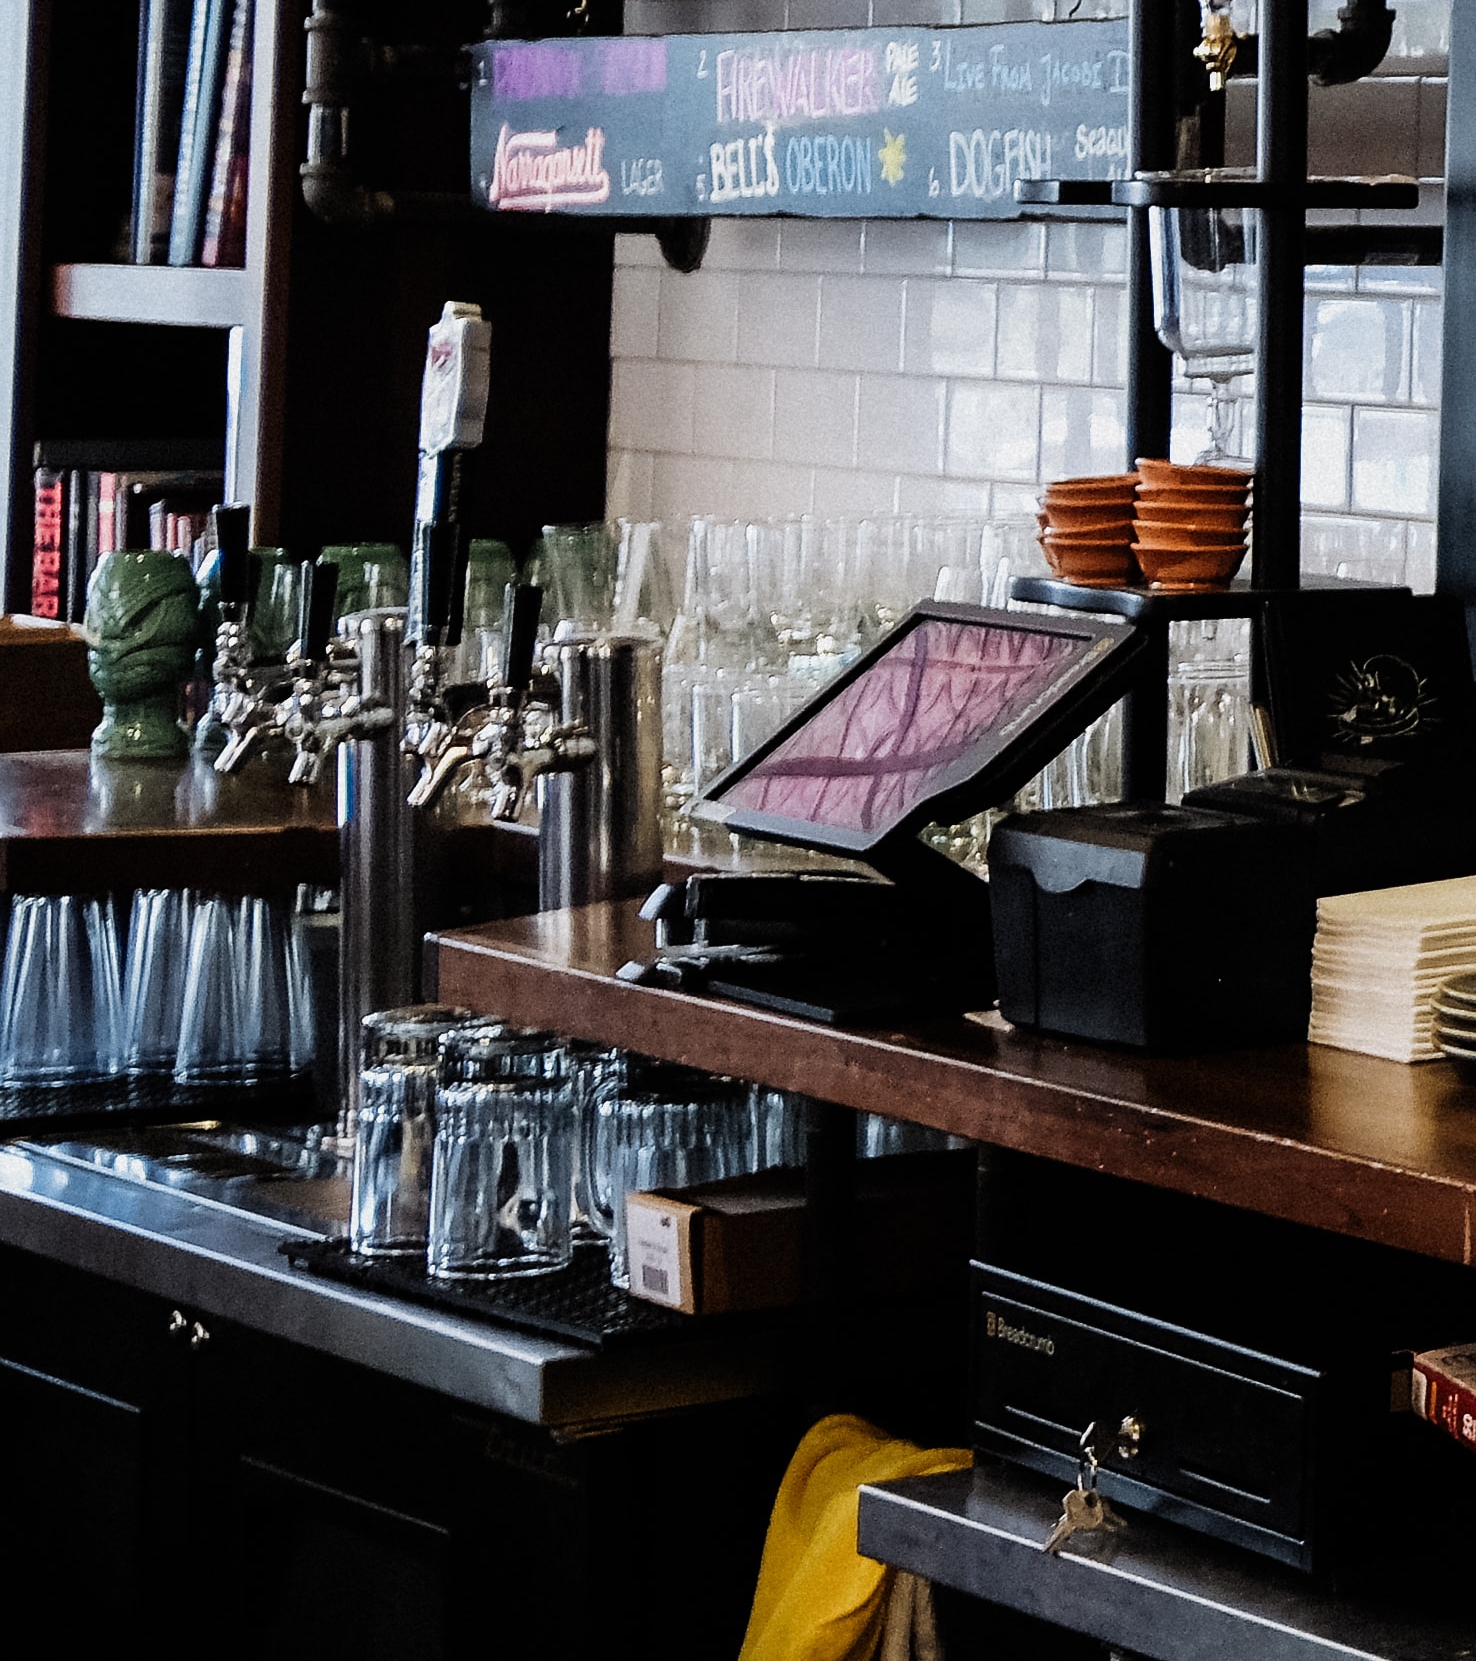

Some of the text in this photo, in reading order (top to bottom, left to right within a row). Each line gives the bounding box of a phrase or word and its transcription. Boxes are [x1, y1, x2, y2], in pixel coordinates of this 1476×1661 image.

[715, 45, 878, 123] FIREWALKER
[784, 135, 873, 197] OBERON
[949, 127, 1052, 199] DOGFISH
